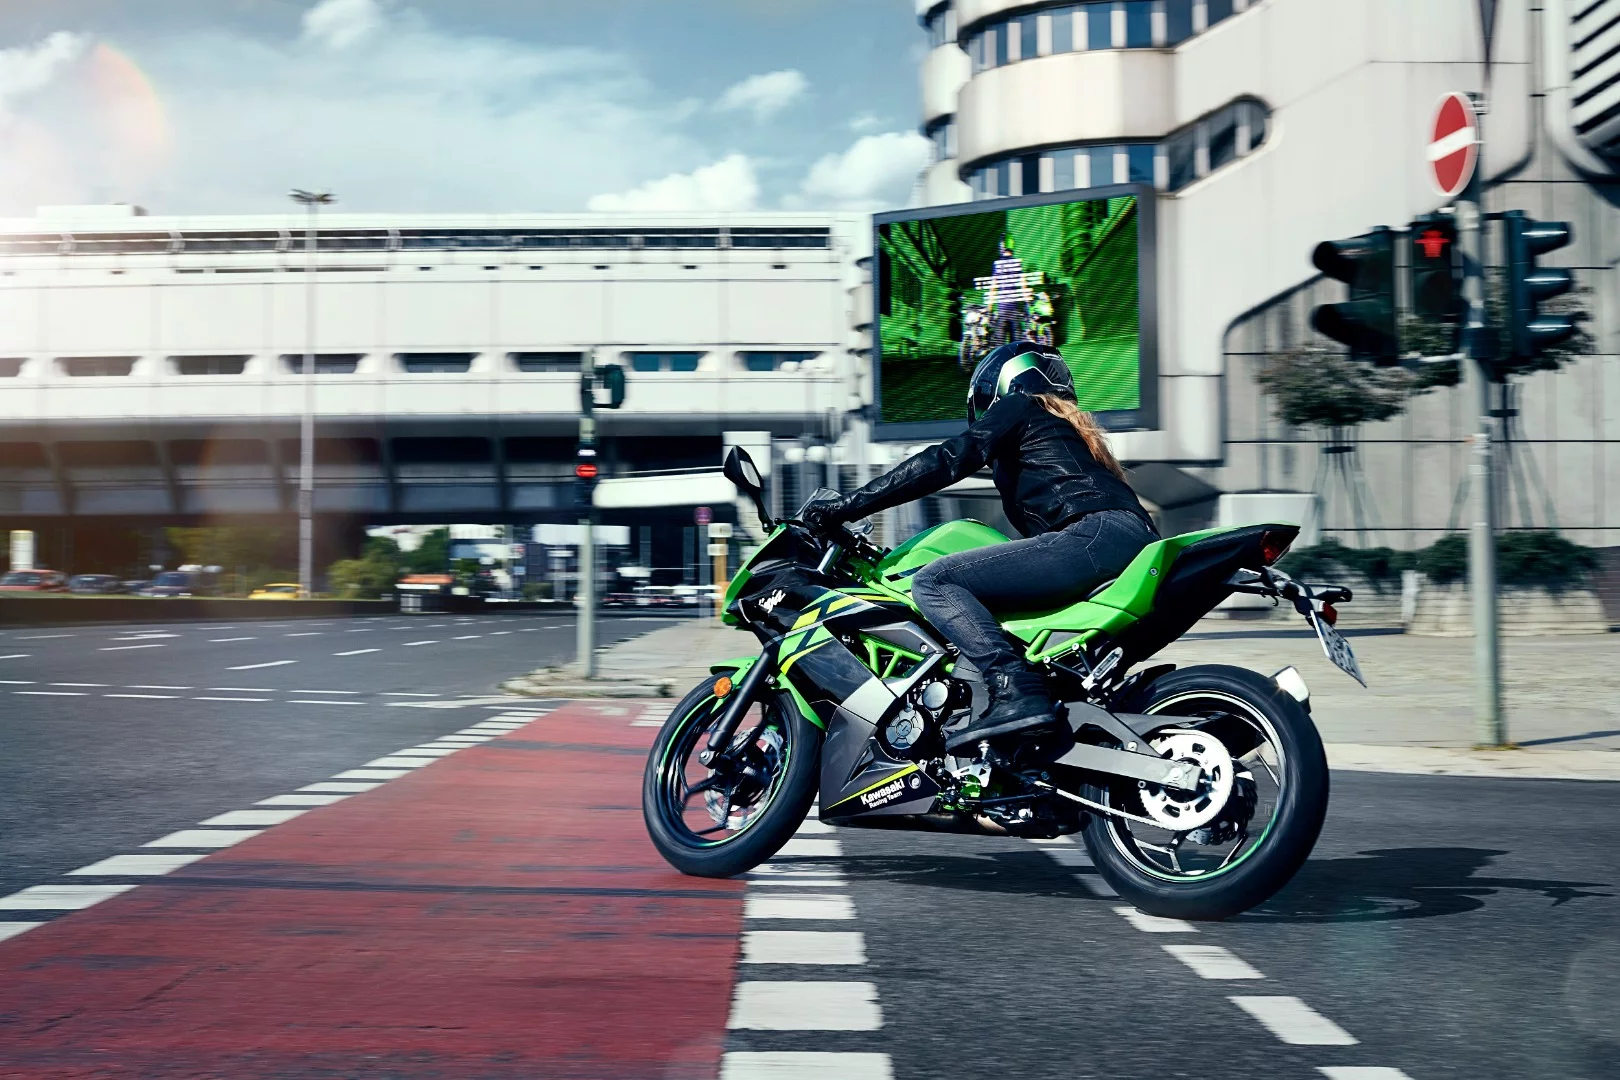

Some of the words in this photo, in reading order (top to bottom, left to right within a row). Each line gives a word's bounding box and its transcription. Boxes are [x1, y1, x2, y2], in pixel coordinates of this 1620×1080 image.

[860, 778, 905, 805] Kawasaki
[868, 797, 888, 808] Racing
[886, 791, 903, 800] Team
